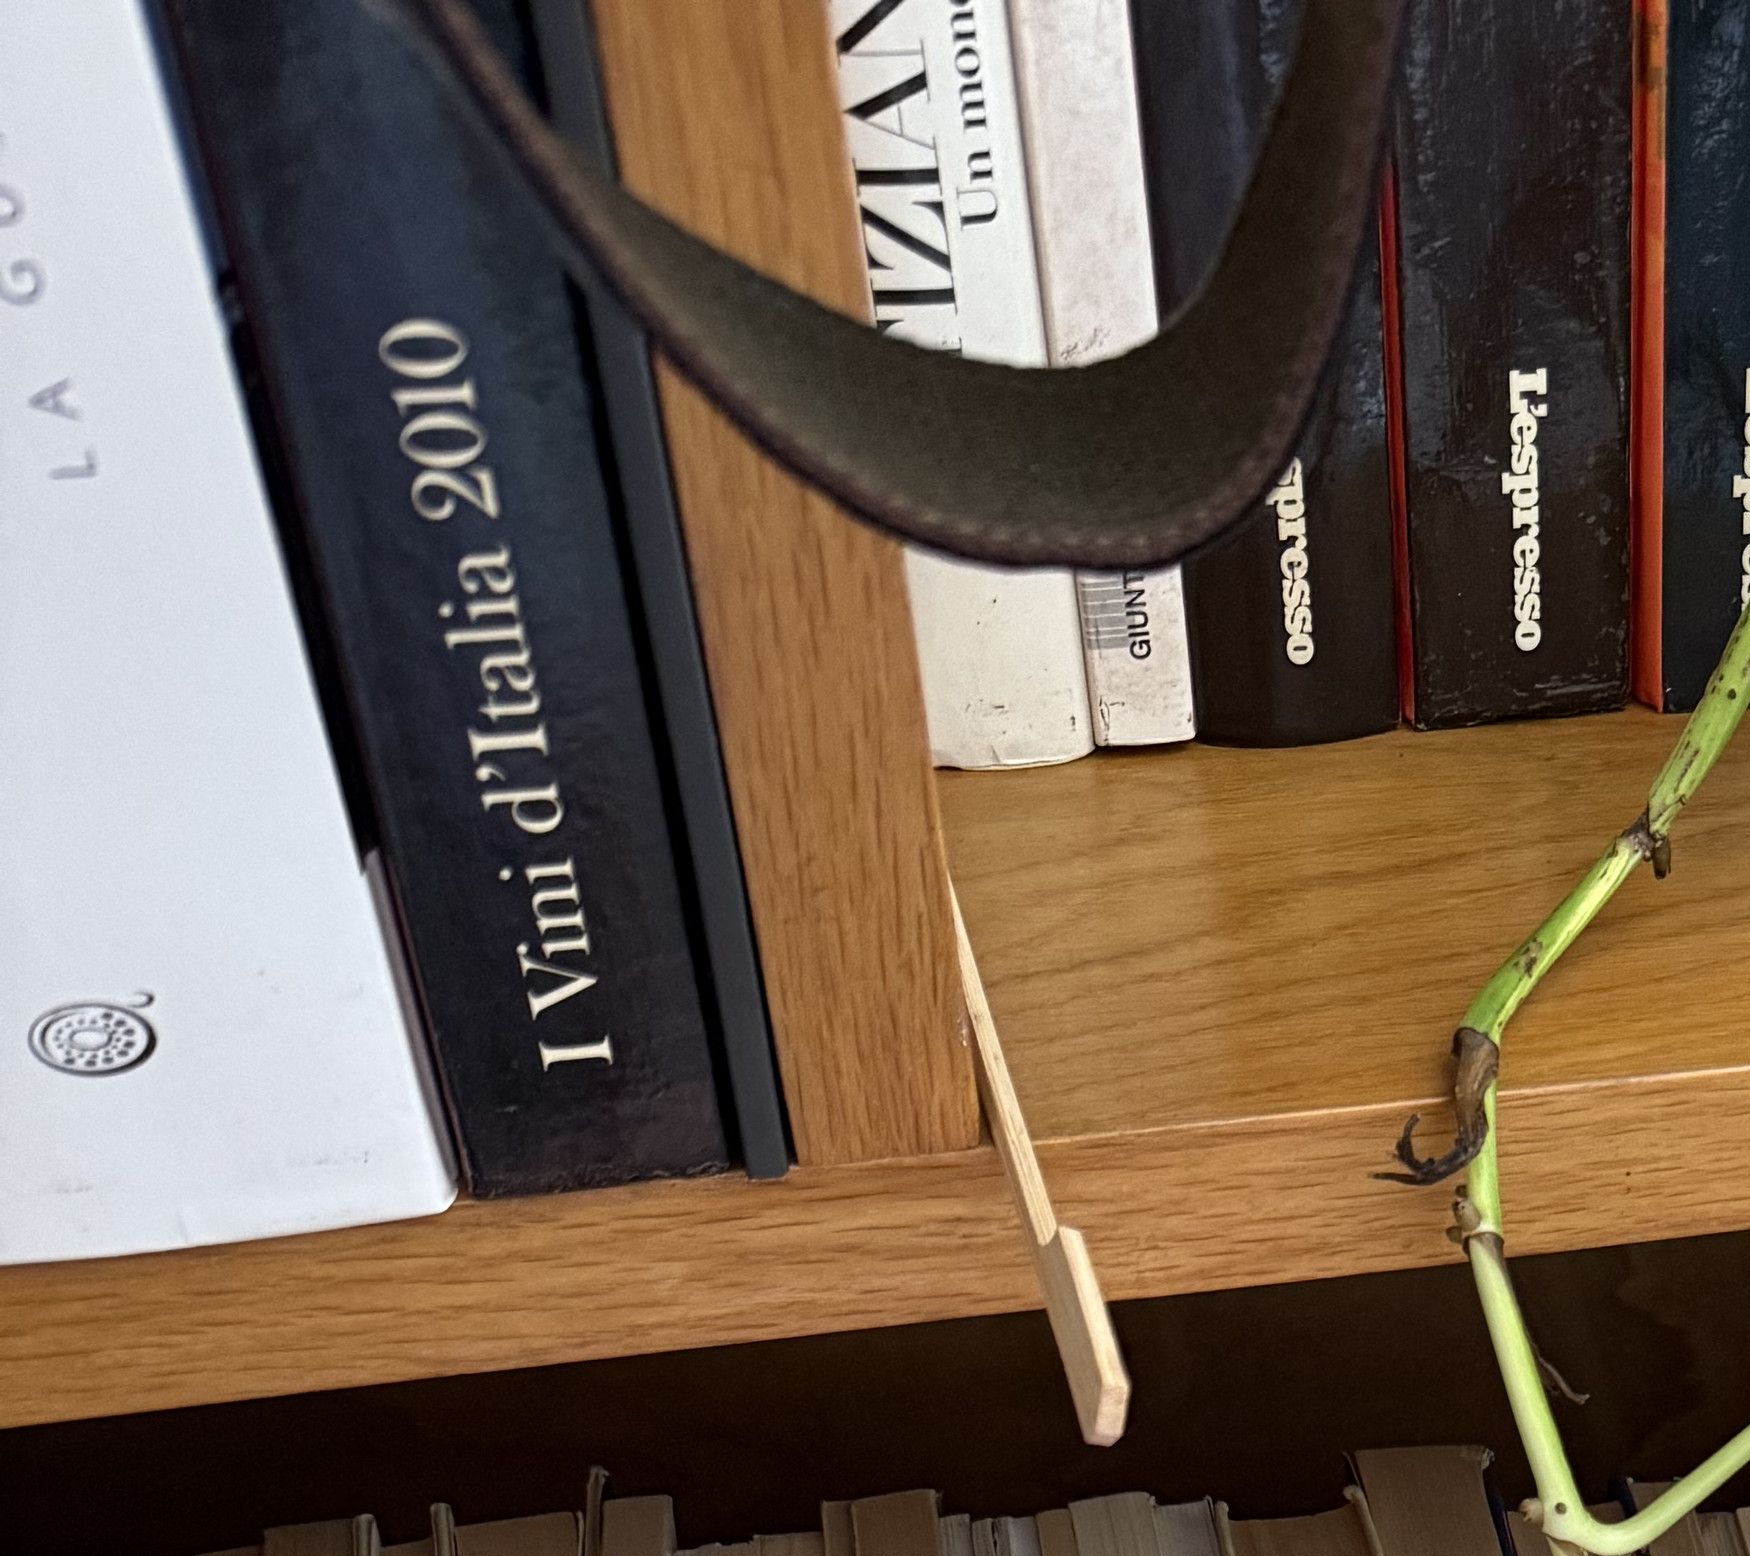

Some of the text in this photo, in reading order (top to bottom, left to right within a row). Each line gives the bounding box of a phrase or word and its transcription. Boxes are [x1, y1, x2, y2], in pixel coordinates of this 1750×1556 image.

[957, 148, 998, 231] Un
[1502, 368, 1548, 651] L'espresso
[378, 317, 615, 1075] I Vini d'Italia 2010
